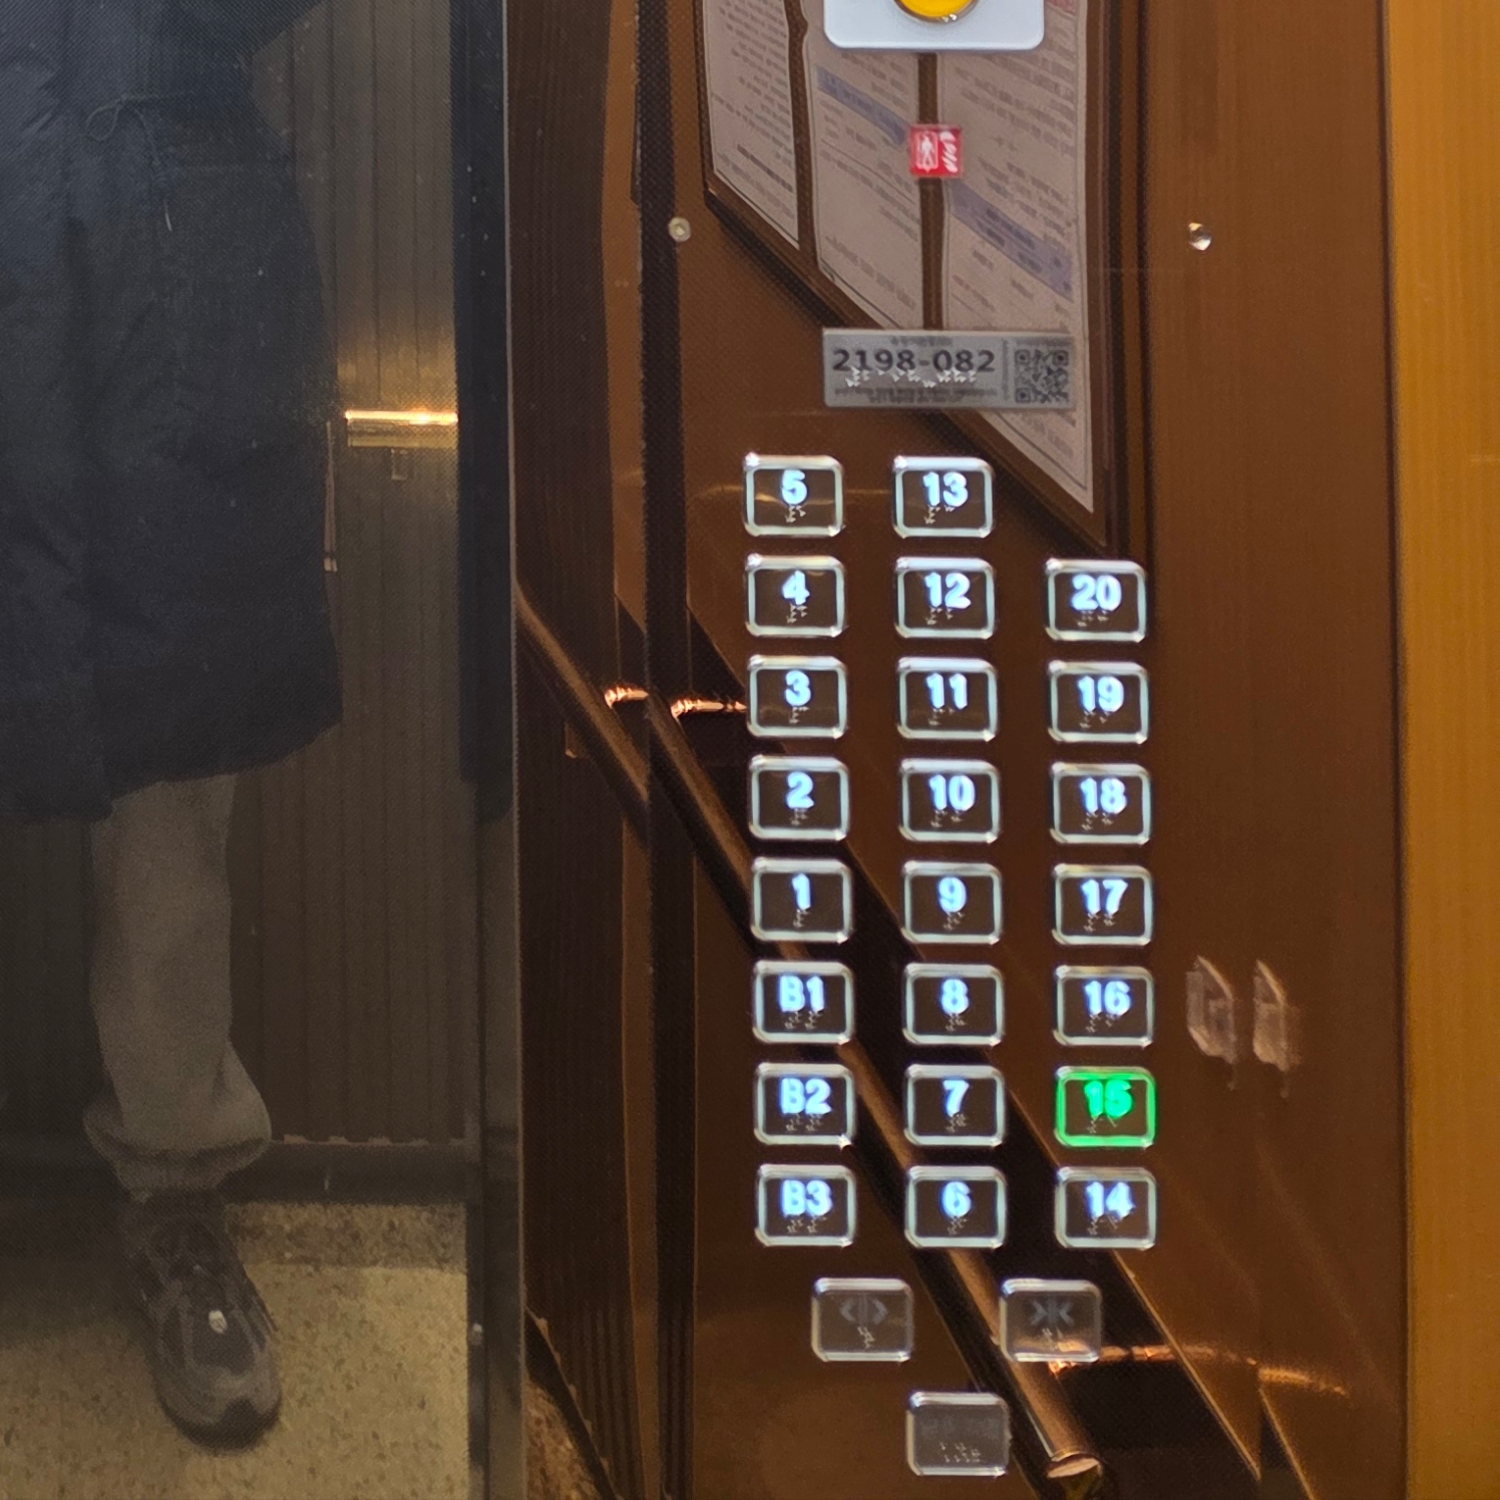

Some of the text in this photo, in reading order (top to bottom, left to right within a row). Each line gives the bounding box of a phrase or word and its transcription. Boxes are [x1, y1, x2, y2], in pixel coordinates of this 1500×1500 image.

[832, 349, 996, 373] 2198-082
[781, 469, 807, 506] 5
[923, 471, 968, 507] 13
[782, 570, 810, 605] 4
[925, 572, 971, 609] 12
[1071, 574, 1122, 611] 20
[785, 671, 811, 706] 3
[926, 672, 968, 709] 11
[1078, 676, 1124, 713] 19
[786, 771, 814, 809] 2
[929, 774, 975, 812] 10
[1080, 777, 1127, 814] 18
[792, 873, 811, 910] 1
[938, 876, 966, 913] 9
[1081, 878, 1128, 916] 17
[778, 974, 825, 1012] B1
[940, 978, 969, 1015] 8
[1084, 980, 1131, 1017] 16
[780, 1077, 832, 1115] B2
[943, 1079, 969, 1117] 7
[1083, 1079, 1133, 1118] 15
[781, 1178, 833, 1217] B3
[942, 1181, 971, 1218] 6
[1085, 1181, 1135, 1220] 14
